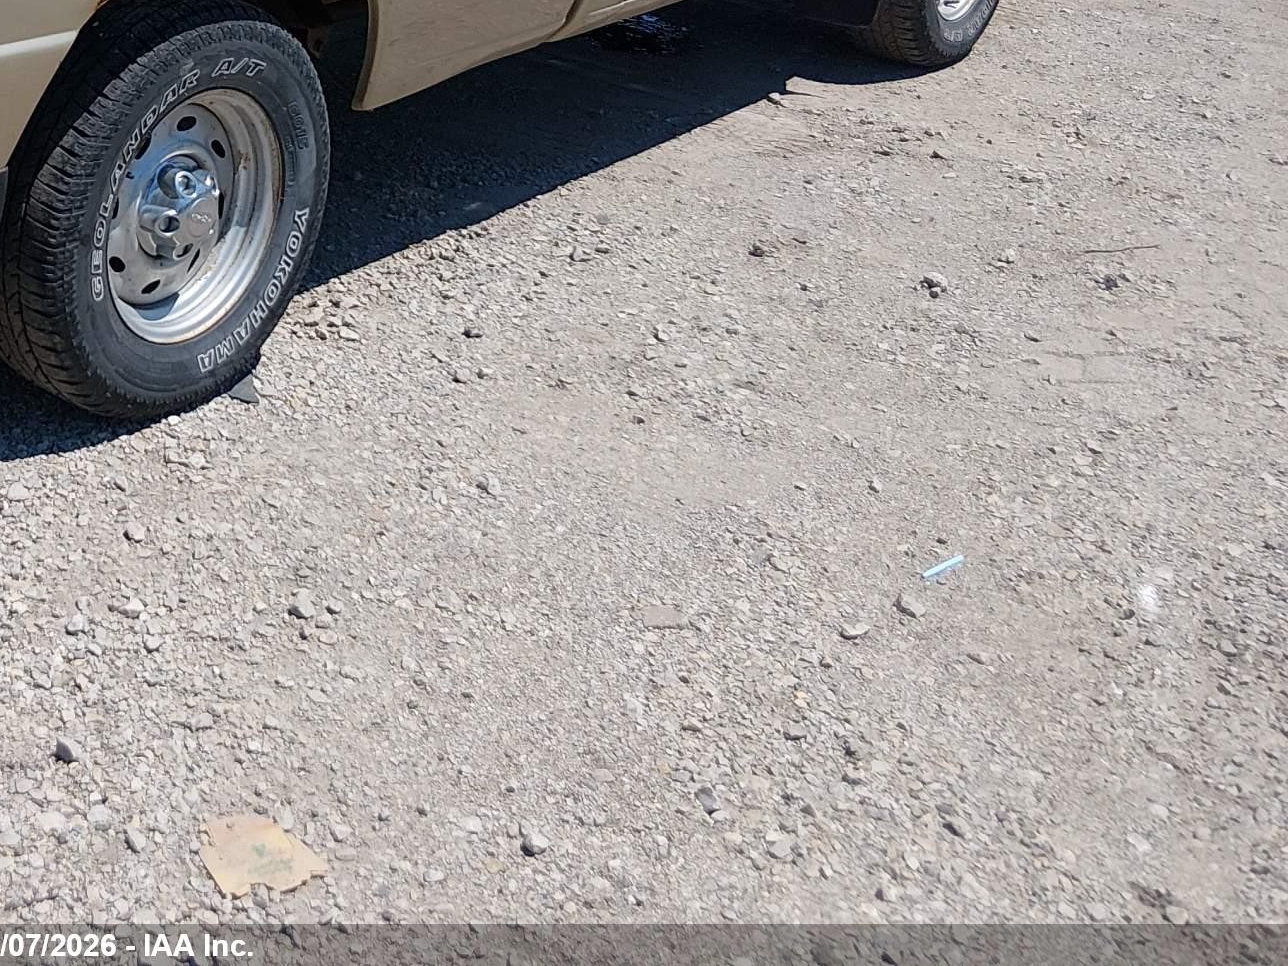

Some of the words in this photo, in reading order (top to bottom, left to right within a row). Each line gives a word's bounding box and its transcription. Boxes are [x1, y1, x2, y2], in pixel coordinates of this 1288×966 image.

[91, 69, 200, 302] GEOLANDAR
[213, 57, 266, 77] A/T
[197, 207, 310, 373] YOKOHAMA
